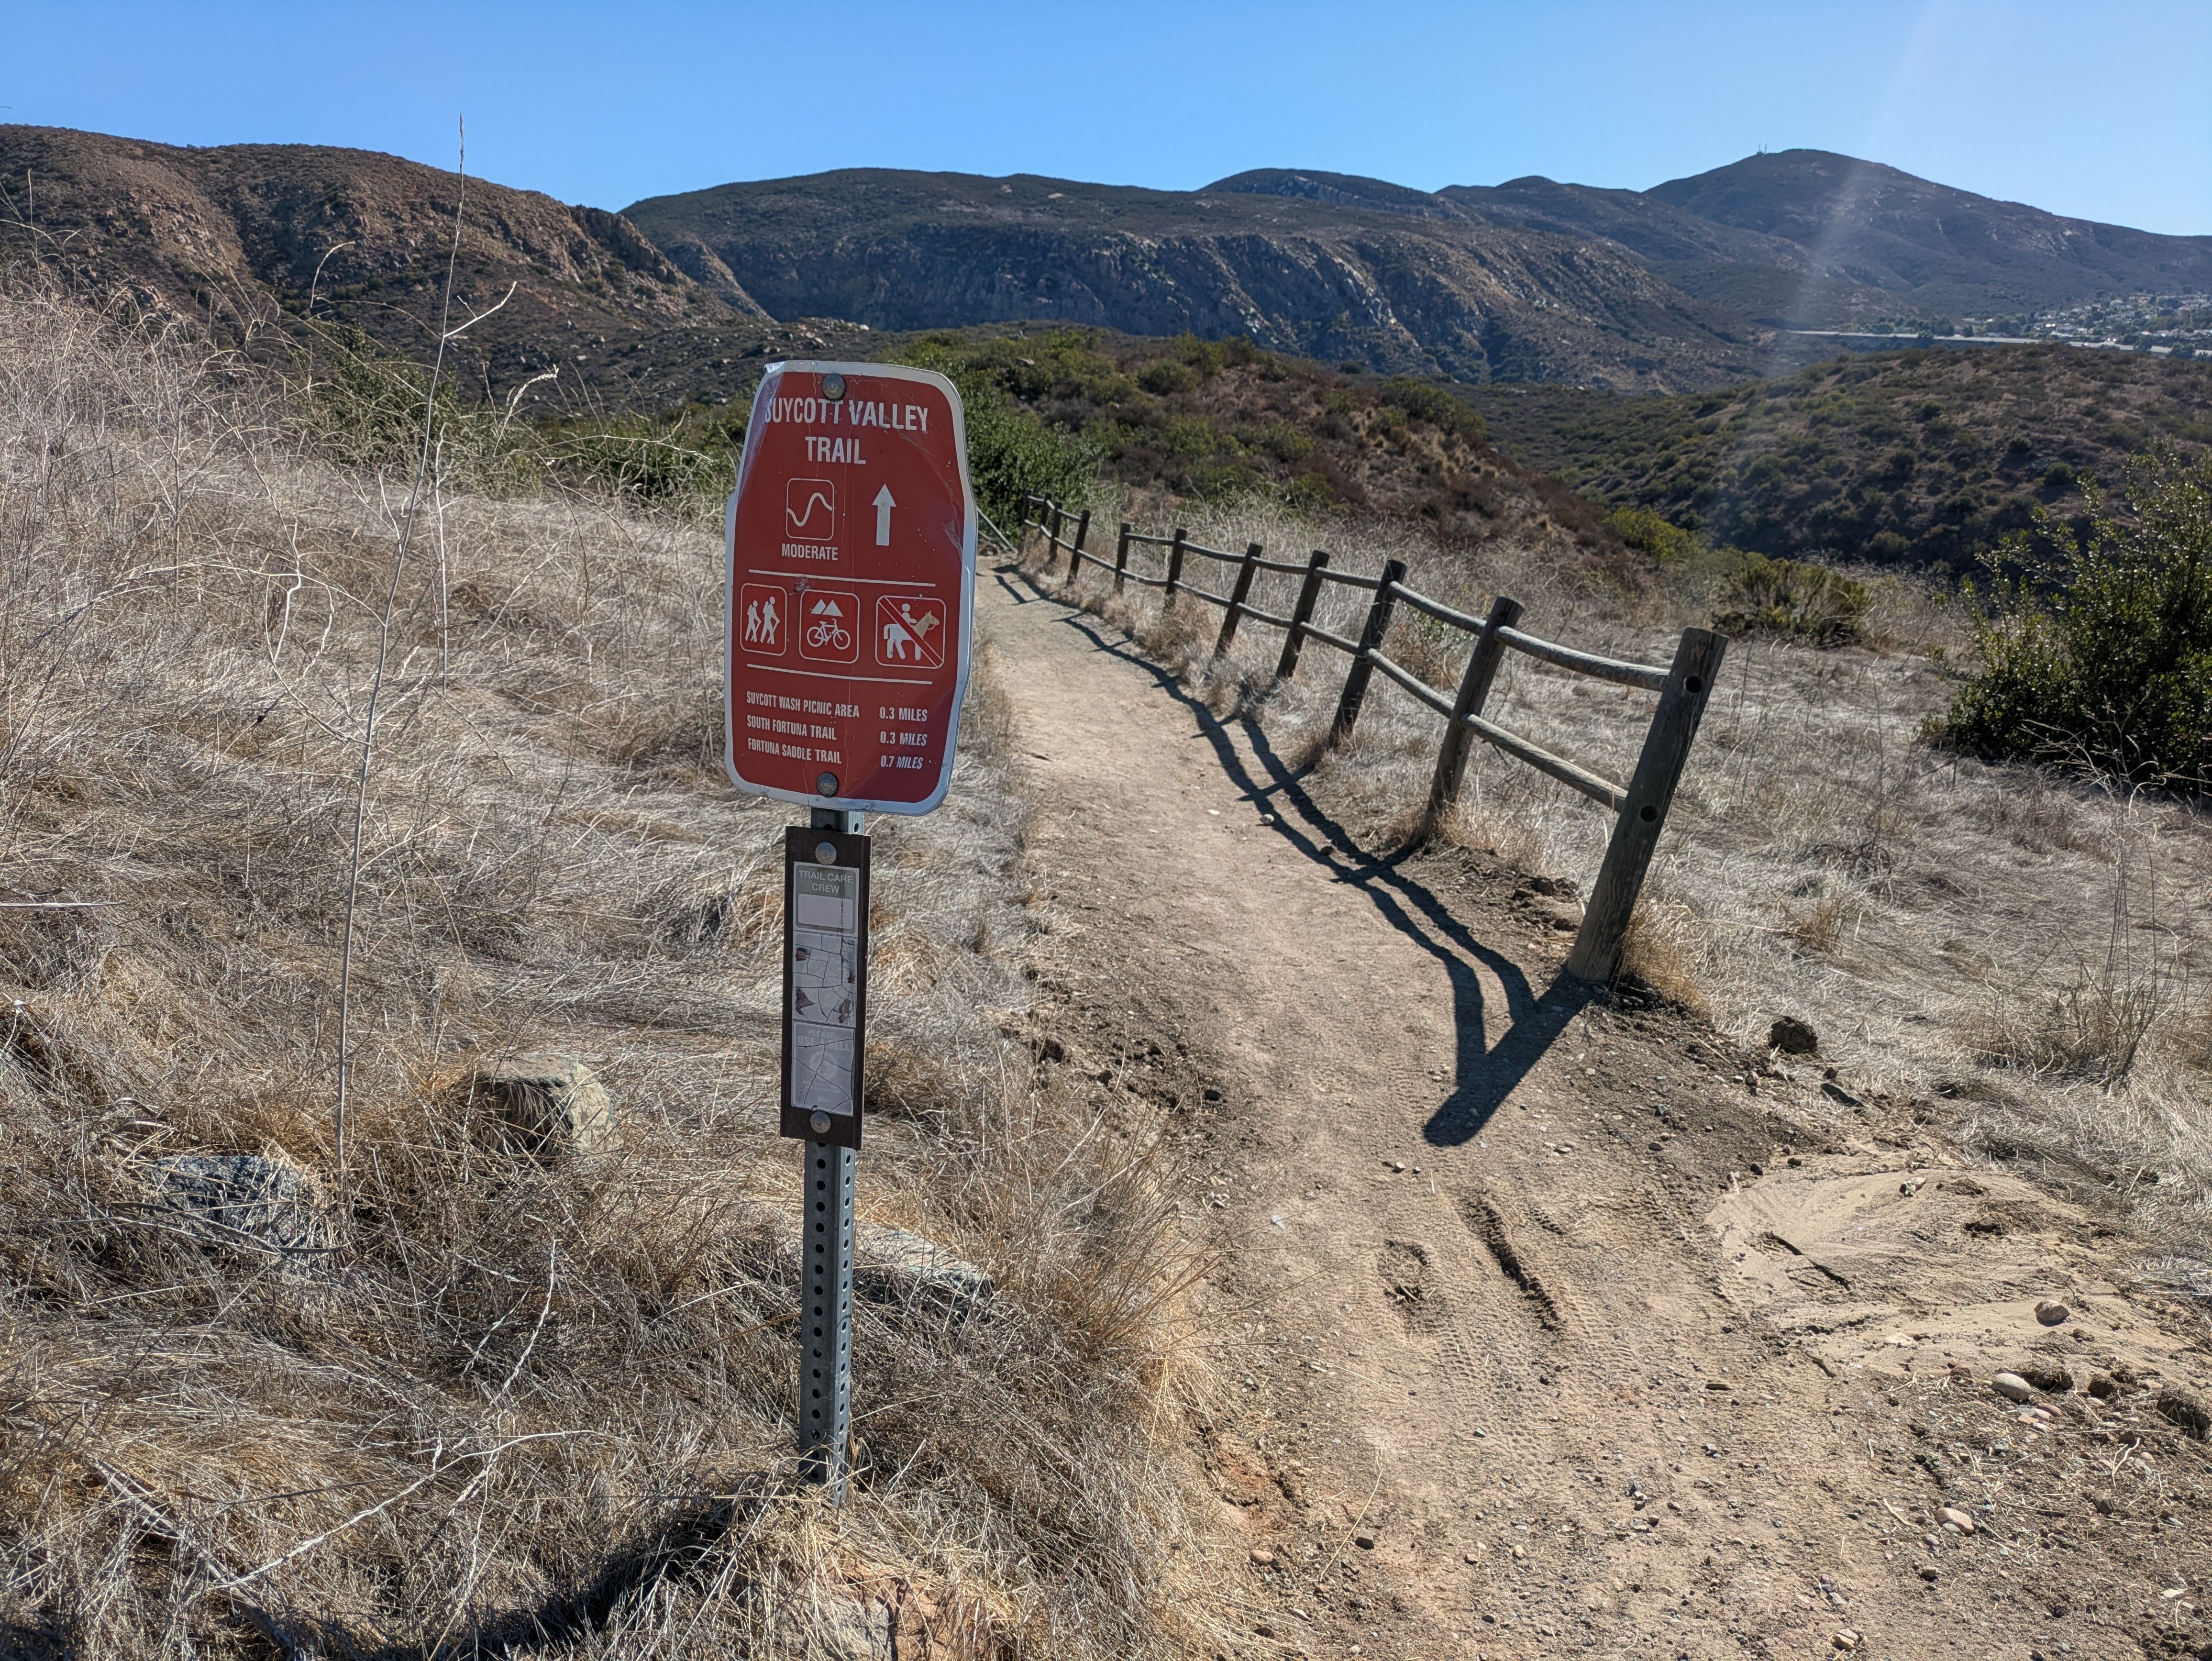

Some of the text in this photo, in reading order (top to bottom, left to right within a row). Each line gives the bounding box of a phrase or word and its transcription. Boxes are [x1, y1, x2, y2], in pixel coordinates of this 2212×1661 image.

[765, 397, 928, 431] SUYCOTT VALLEY
[805, 436, 866, 465] TRAIL
[782, 543, 838, 561] MODERATE
[746, 691, 928, 721] SUYCOTT WASH PICNIC AREA 0.3 MILES
[747, 715, 928, 746] SOUTH FORTUNA TRAIL 0.3 MILES
[748, 738, 923, 769] FORTUNA SADDLE TRAIL 0.7 MILES
[798, 870, 853, 884] TRAIL CARE
[811, 883, 840, 893] CREW
[797, 1036, 815, 1046] USE
[828, 1040, 851, 1052] BELL
